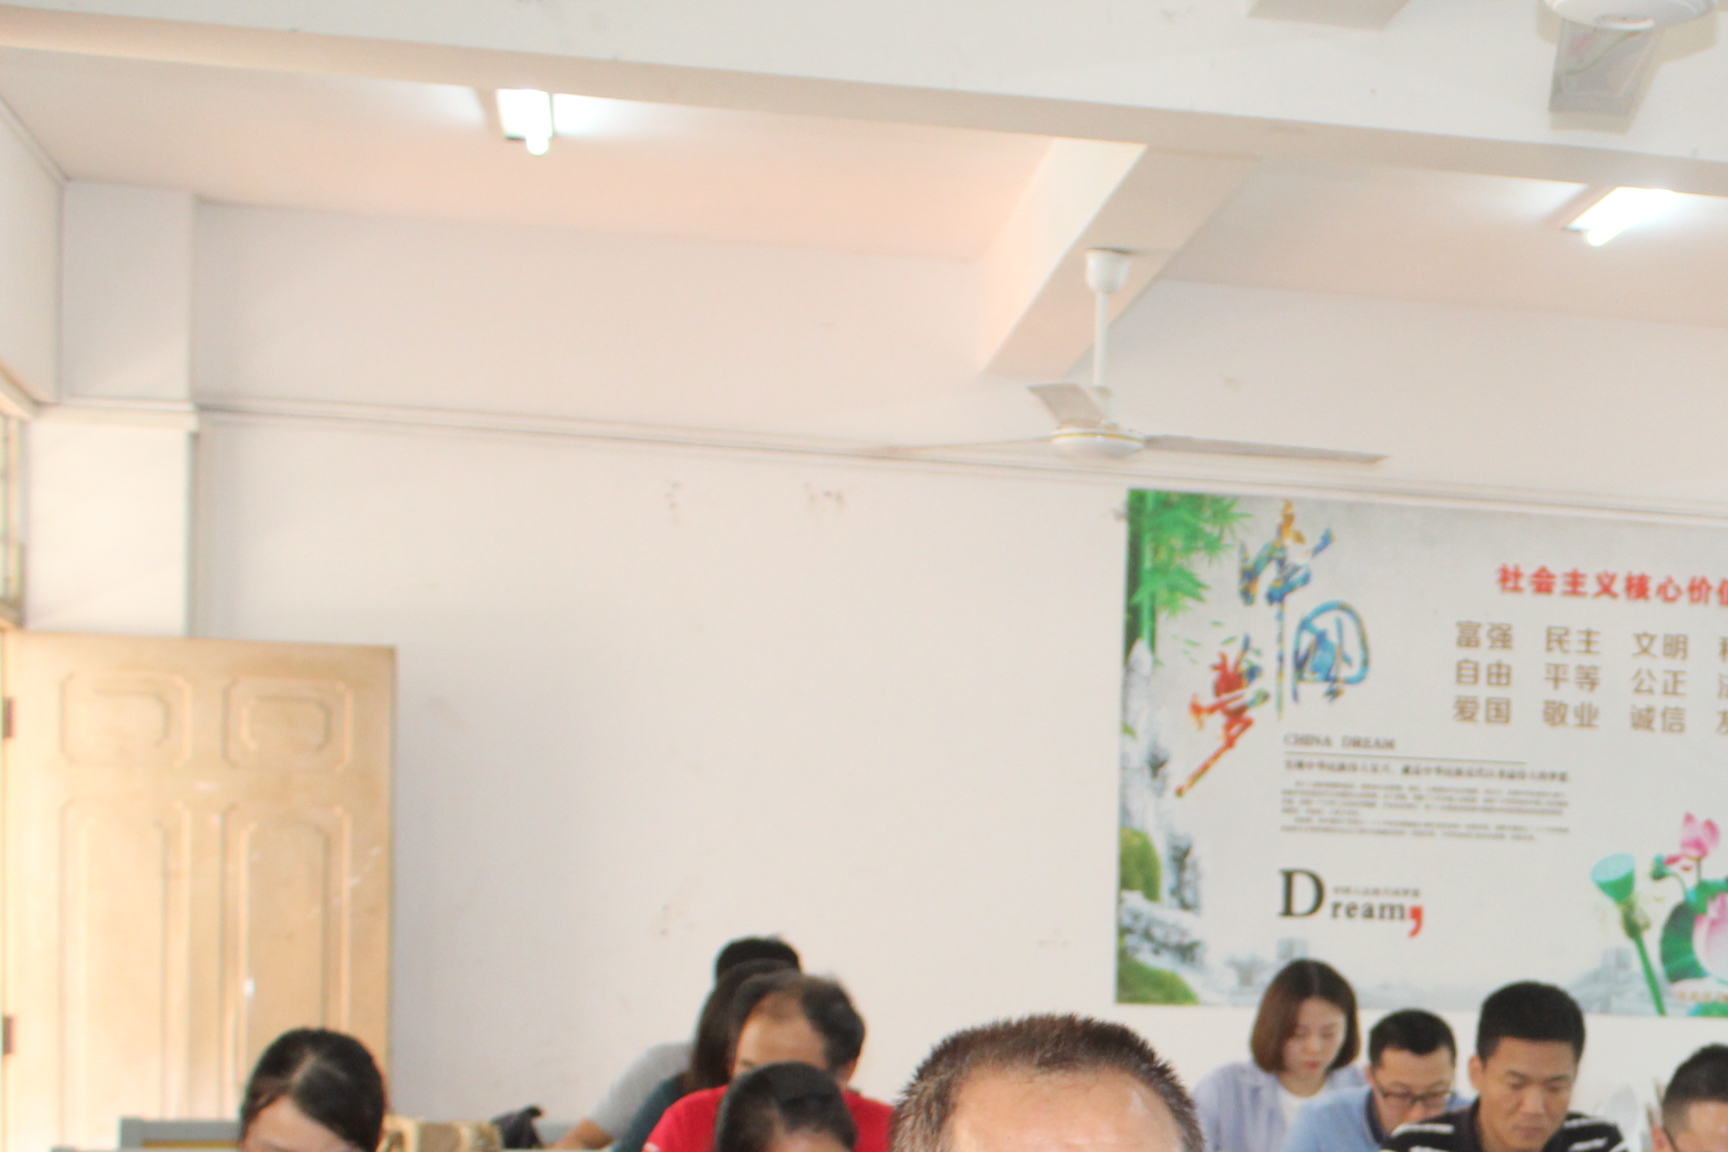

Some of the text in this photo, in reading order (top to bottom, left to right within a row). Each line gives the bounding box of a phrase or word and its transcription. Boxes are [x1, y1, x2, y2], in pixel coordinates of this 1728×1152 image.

[1456, 620, 1513, 651] 富强
[1546, 625, 1600, 655] 民主
[1632, 631, 1688, 661] 文明
[1456, 658, 1512, 688] 自由
[1544, 662, 1600, 692] 平等
[1631, 667, 1688, 697] 公正
[1453, 695, 1511, 725] 爱国
[1543, 699, 1600, 728] 敬业
[1630, 704, 1686, 734] 诚信
